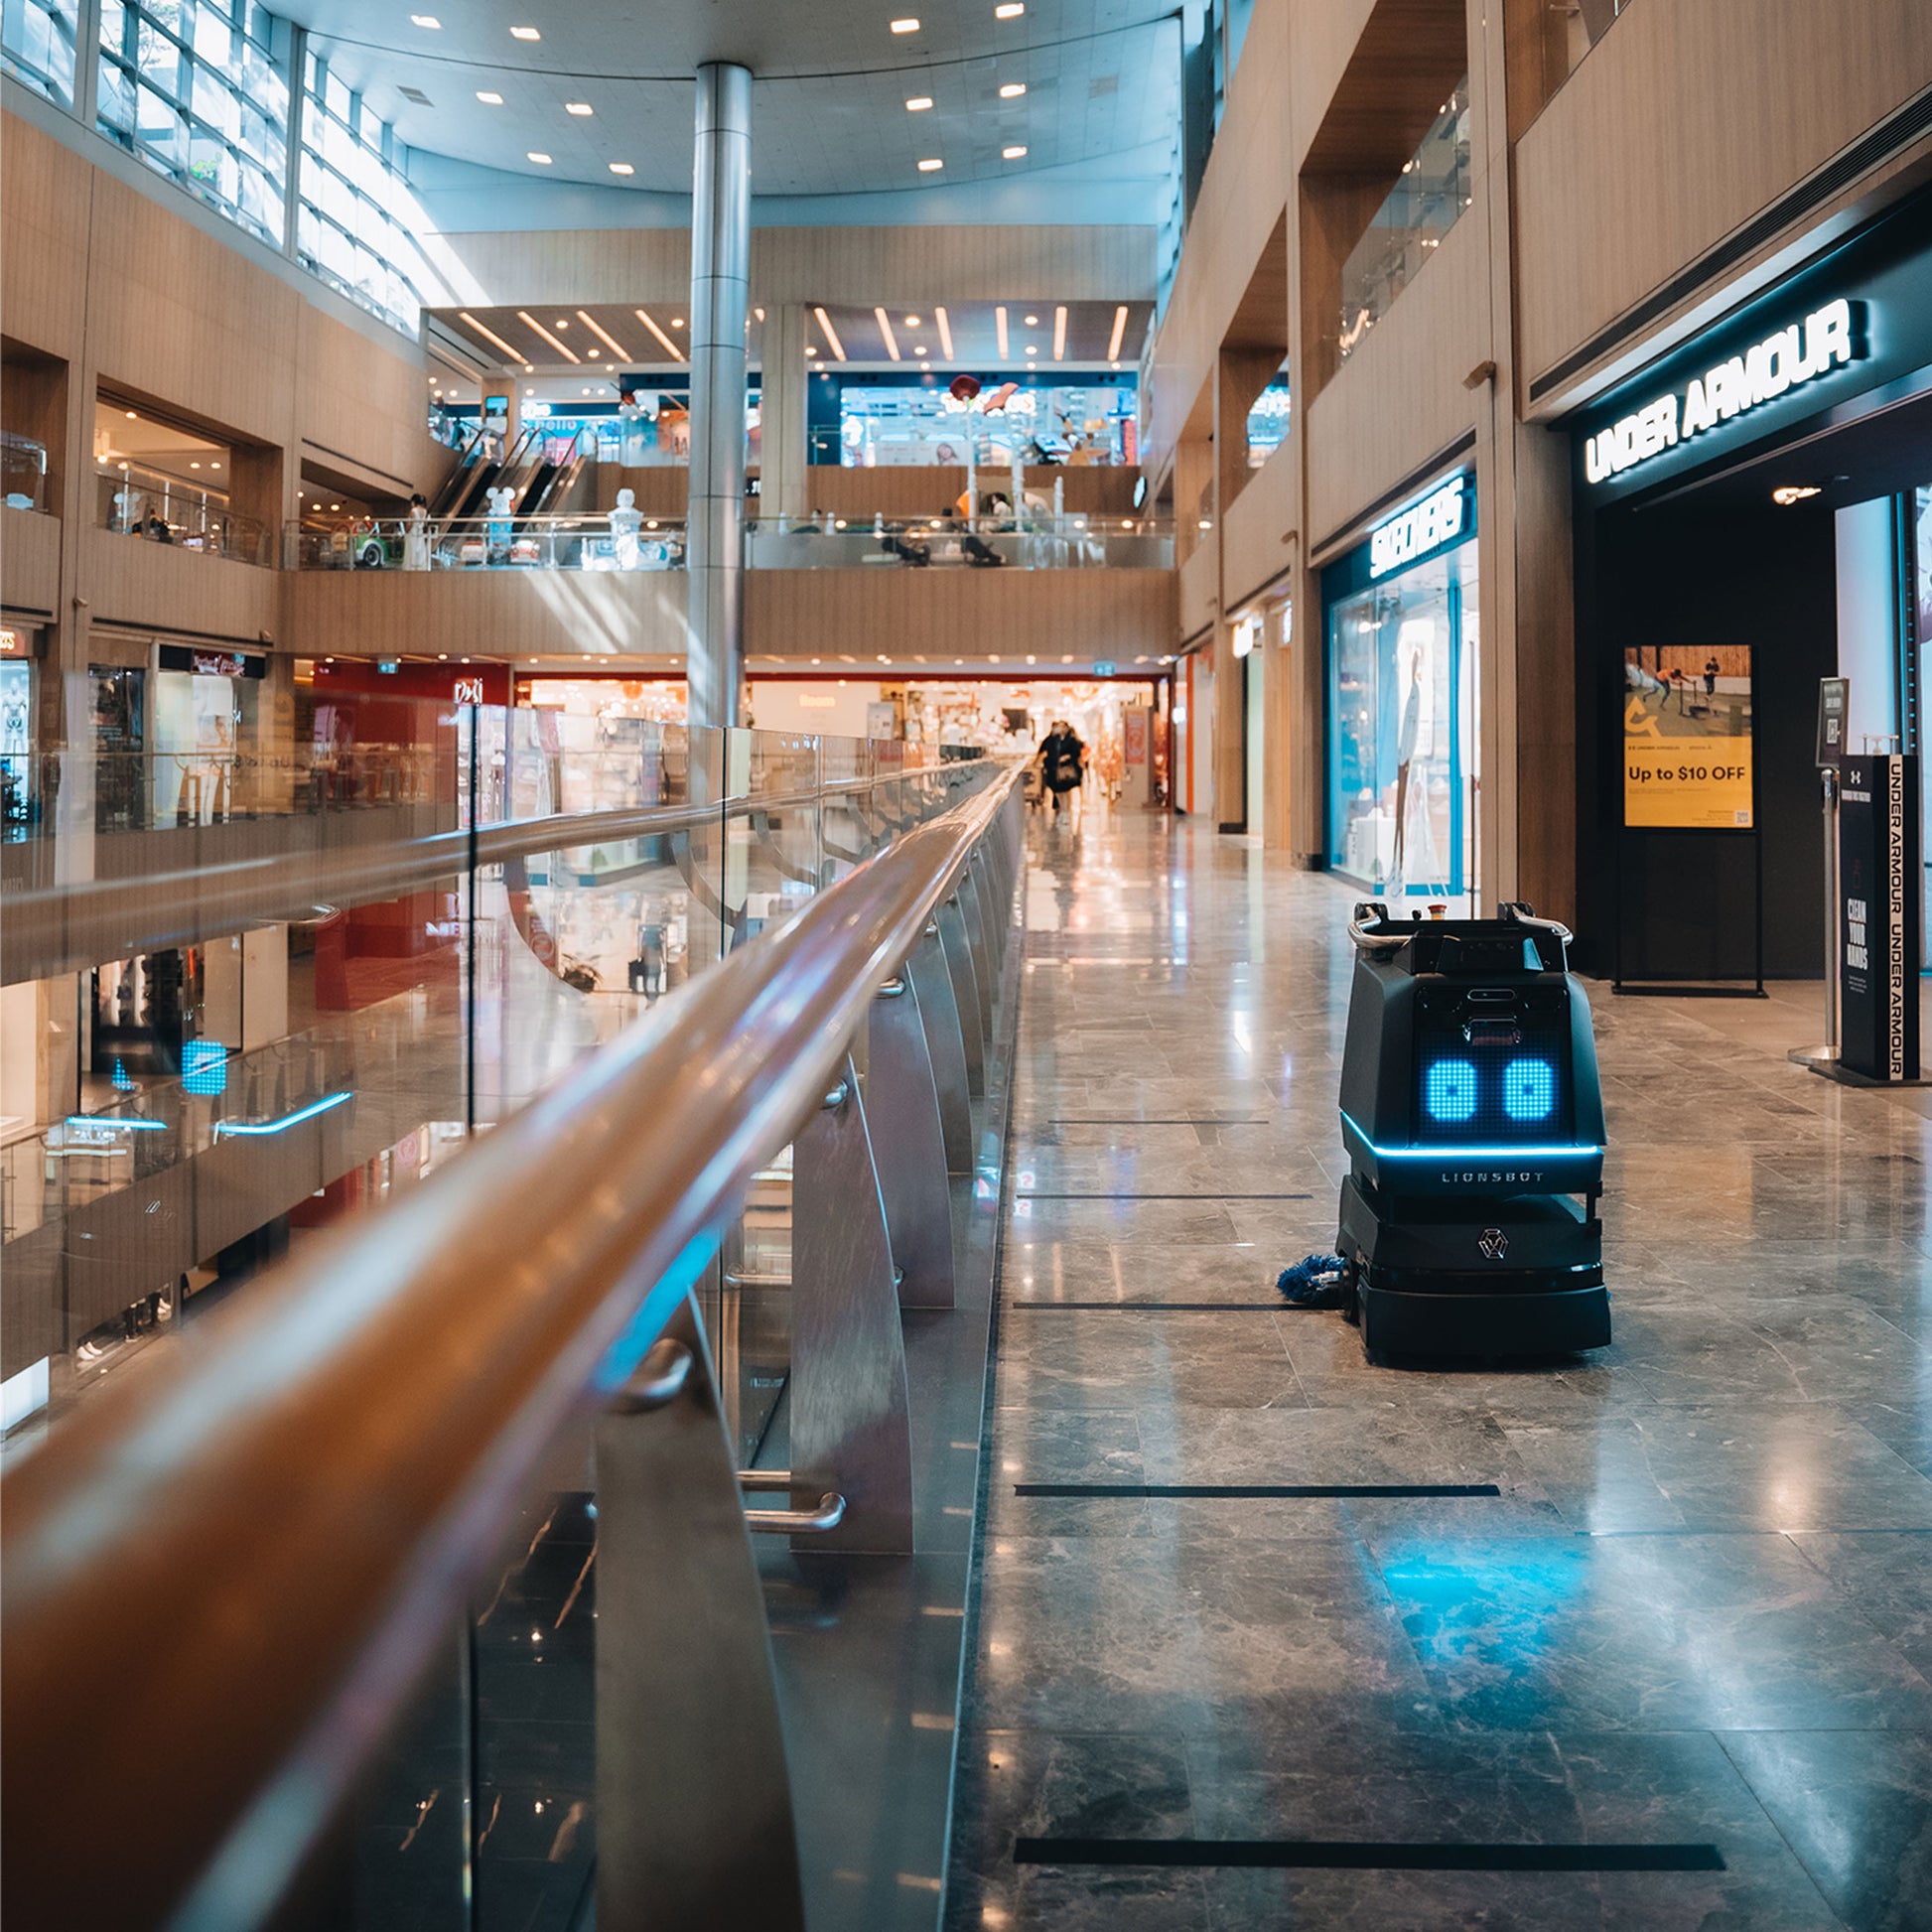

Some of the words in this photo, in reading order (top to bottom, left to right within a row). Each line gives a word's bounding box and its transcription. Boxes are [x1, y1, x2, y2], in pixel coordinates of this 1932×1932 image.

[1587, 393, 1679, 484] UNDER
[1682, 298, 1852, 439] ARMOUR
[1628, 765, 1652, 783] Up
[1656, 767, 1674, 780] to
[1678, 765, 1708, 781] $10
[1712, 765, 1746, 780] OFF
[1890, 762, 1901, 828] UNDER
[1890, 831, 1902, 914] ARMOUR
[1891, 923, 1902, 988] UNDER
[1891, 992, 1902, 1074] ARMOUR
[1441, 1172, 1544, 1183] LIONSBOT
